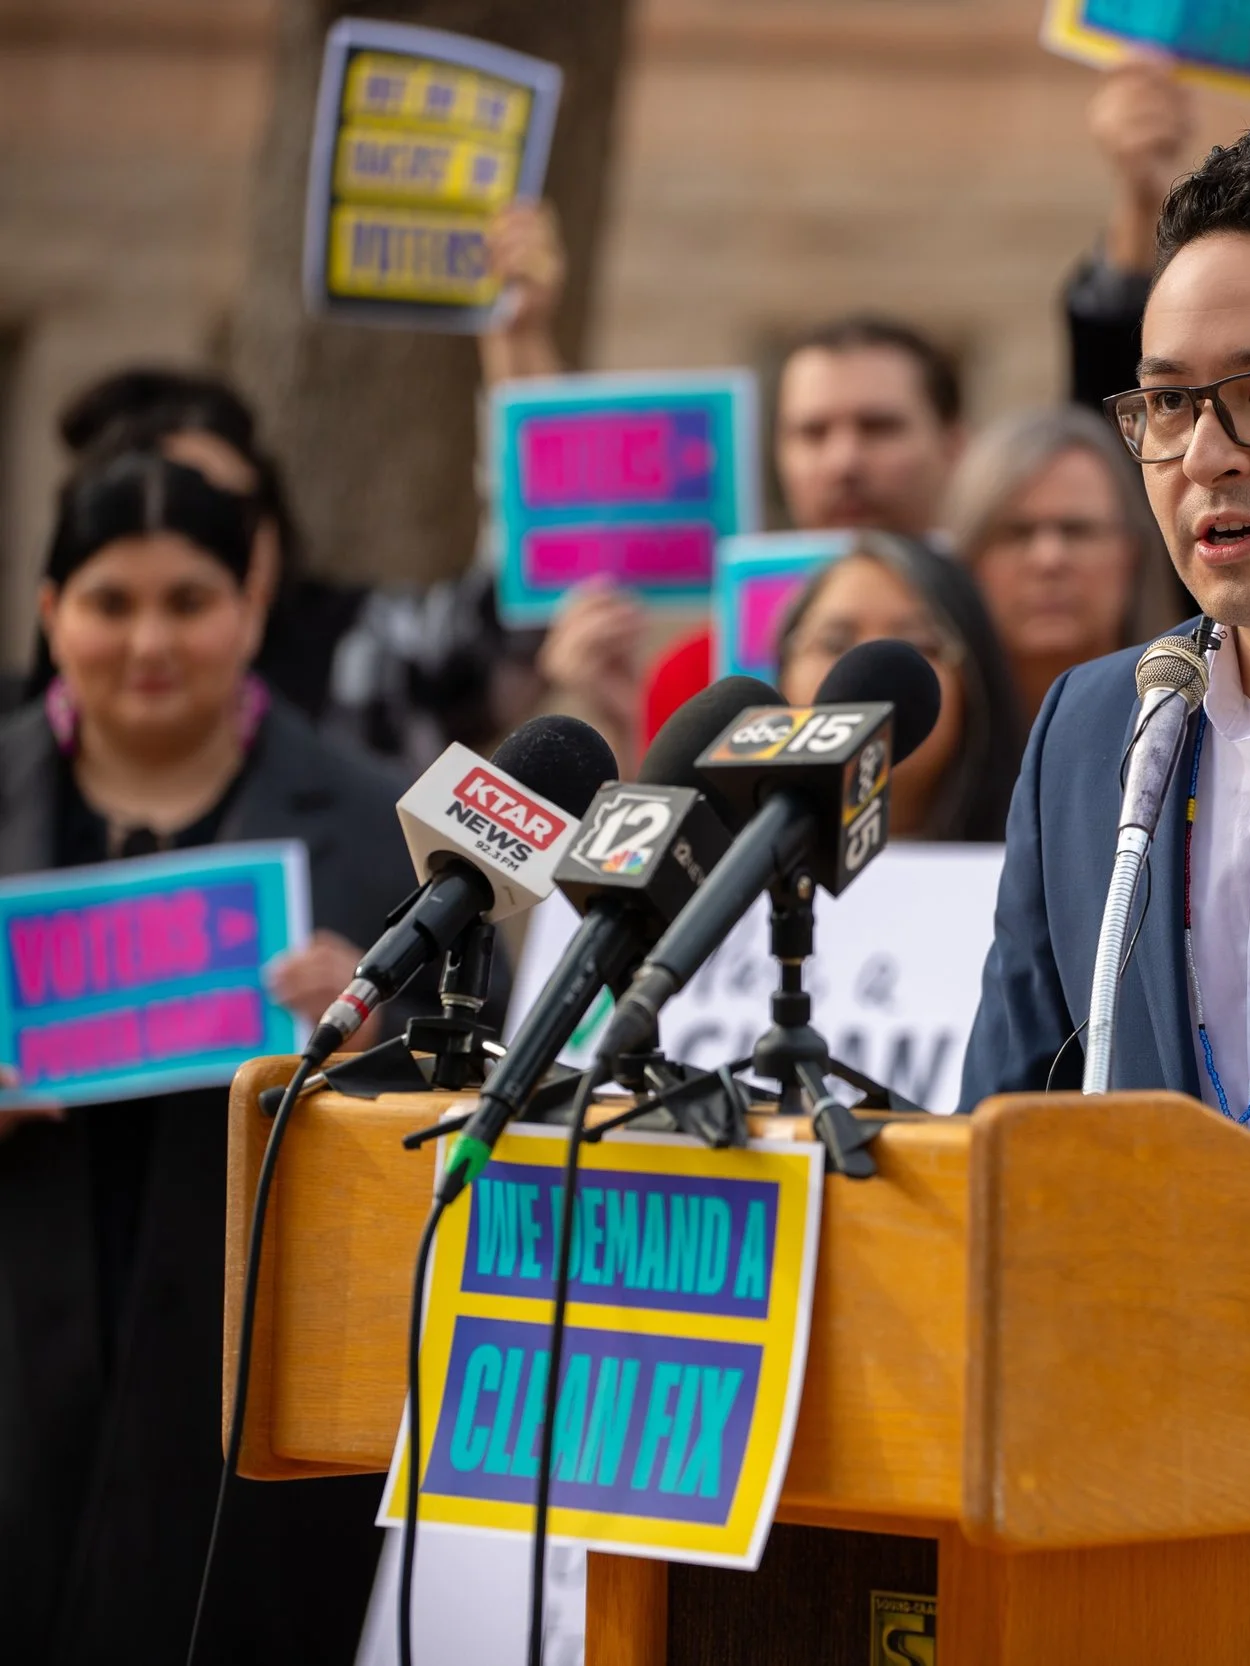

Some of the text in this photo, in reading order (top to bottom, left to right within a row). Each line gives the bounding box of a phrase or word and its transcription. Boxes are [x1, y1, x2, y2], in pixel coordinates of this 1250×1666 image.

[787, 713, 867, 754] 15
[445, 800, 534, 863] NEWS
[463, 776, 553, 844] KTAR
[586, 802, 672, 861] 12
[845, 797, 881, 872] 15
[475, 840, 520, 872] 92.3 FM
[476, 1178, 767, 1301] WE DEMAND A
[449, 1343, 744, 1499] CLEAN FIX
